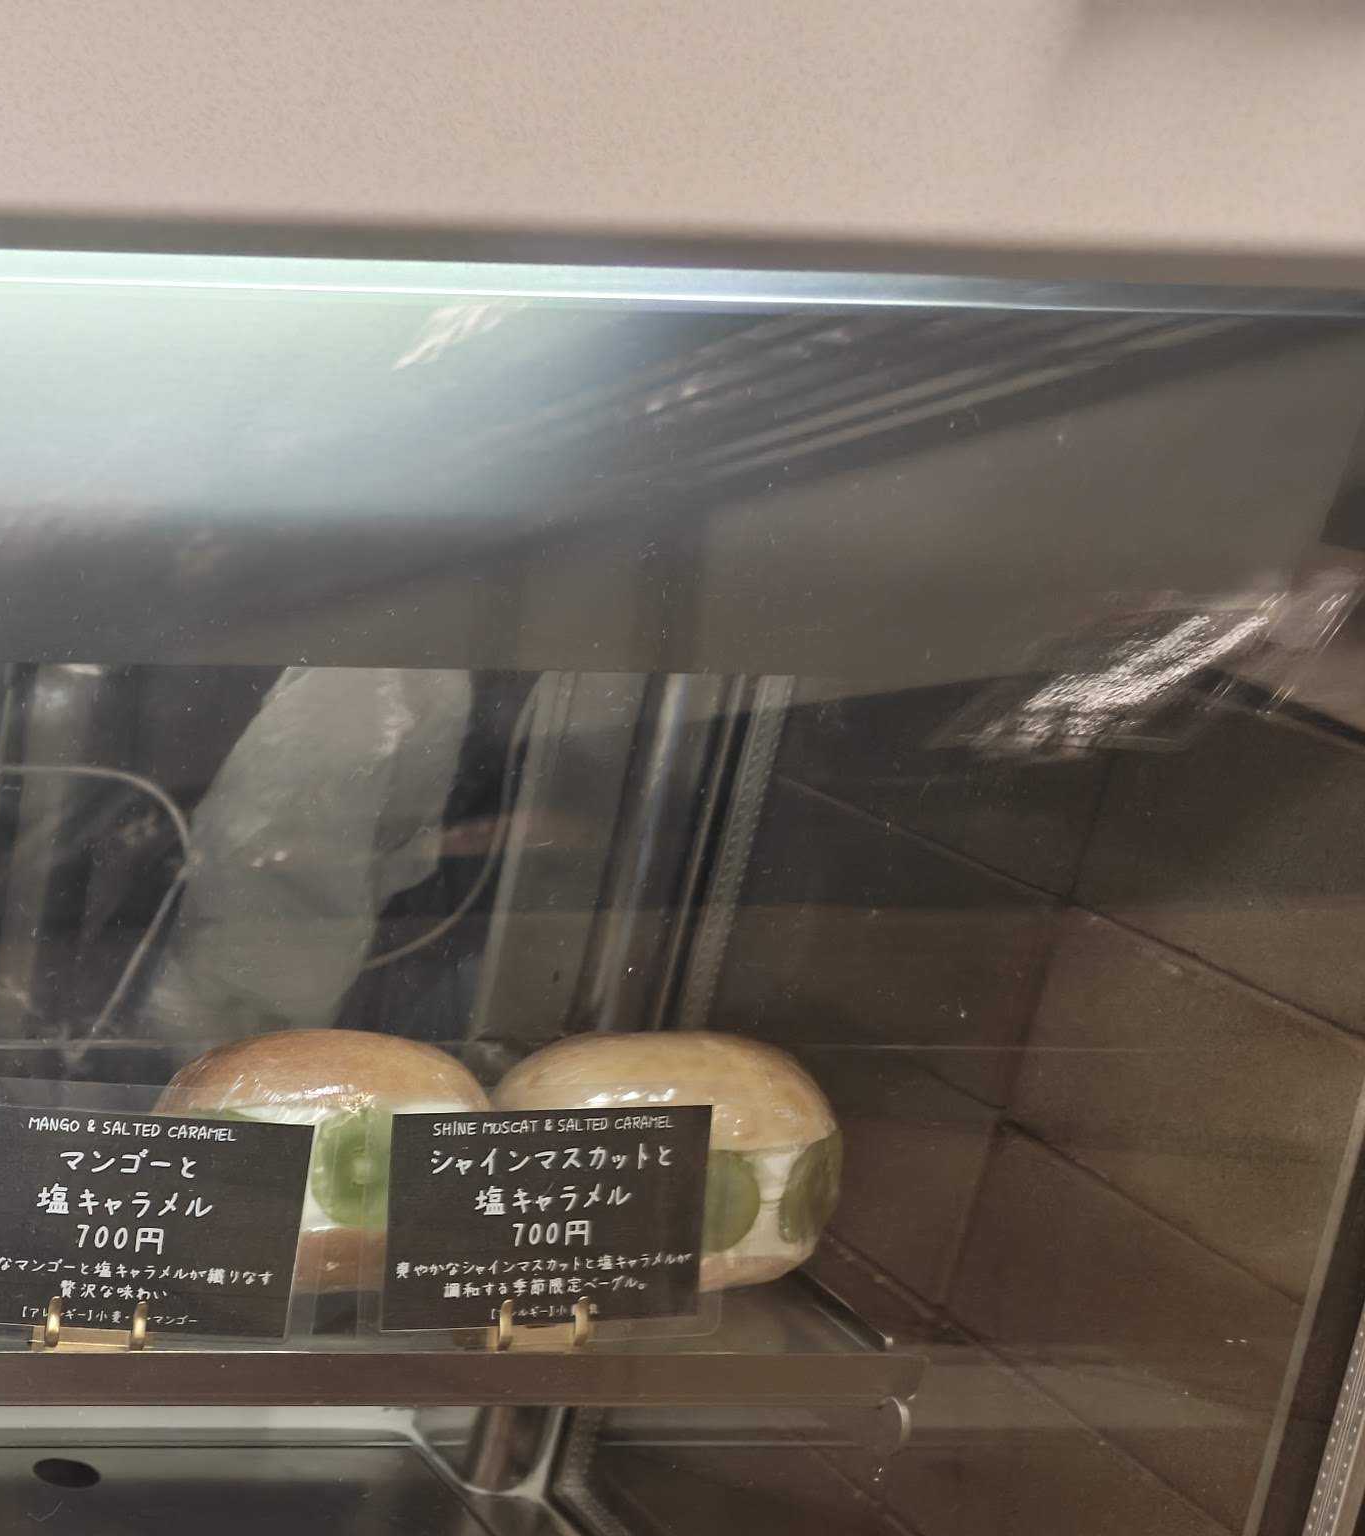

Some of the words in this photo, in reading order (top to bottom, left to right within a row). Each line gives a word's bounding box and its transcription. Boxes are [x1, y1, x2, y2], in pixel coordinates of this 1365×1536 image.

[28, 1116, 80, 1133] MANGO
[87, 1119, 96, 1133] &
[101, 1121, 161, 1138] SALTED
[168, 1126, 237, 1142] CARAMEL
[433, 1120, 478, 1137] SHINE
[544, 1118, 553, 1132] &
[557, 1117, 609, 1133] SALTED
[614, 1115, 675, 1131] CARAMEL
[60, 1148, 197, 1179] マンゴーと
[431, 1143, 673, 1176] シャインマスカットと
[36, 1183, 213, 1218] 塩キャラメル
[475, 1183, 632, 1216] 塩キャラメル
[76, 1224, 165, 1255] 700円
[512, 1220, 591, 1247] 700円
[396, 1251, 693, 1279] 爽やかなシャインマスカットと塩キャラメルが
[60, 1280, 168, 1301] 贅沢な味わい
[443, 1276, 649, 1299] 調和する季節限定ベーグル。
